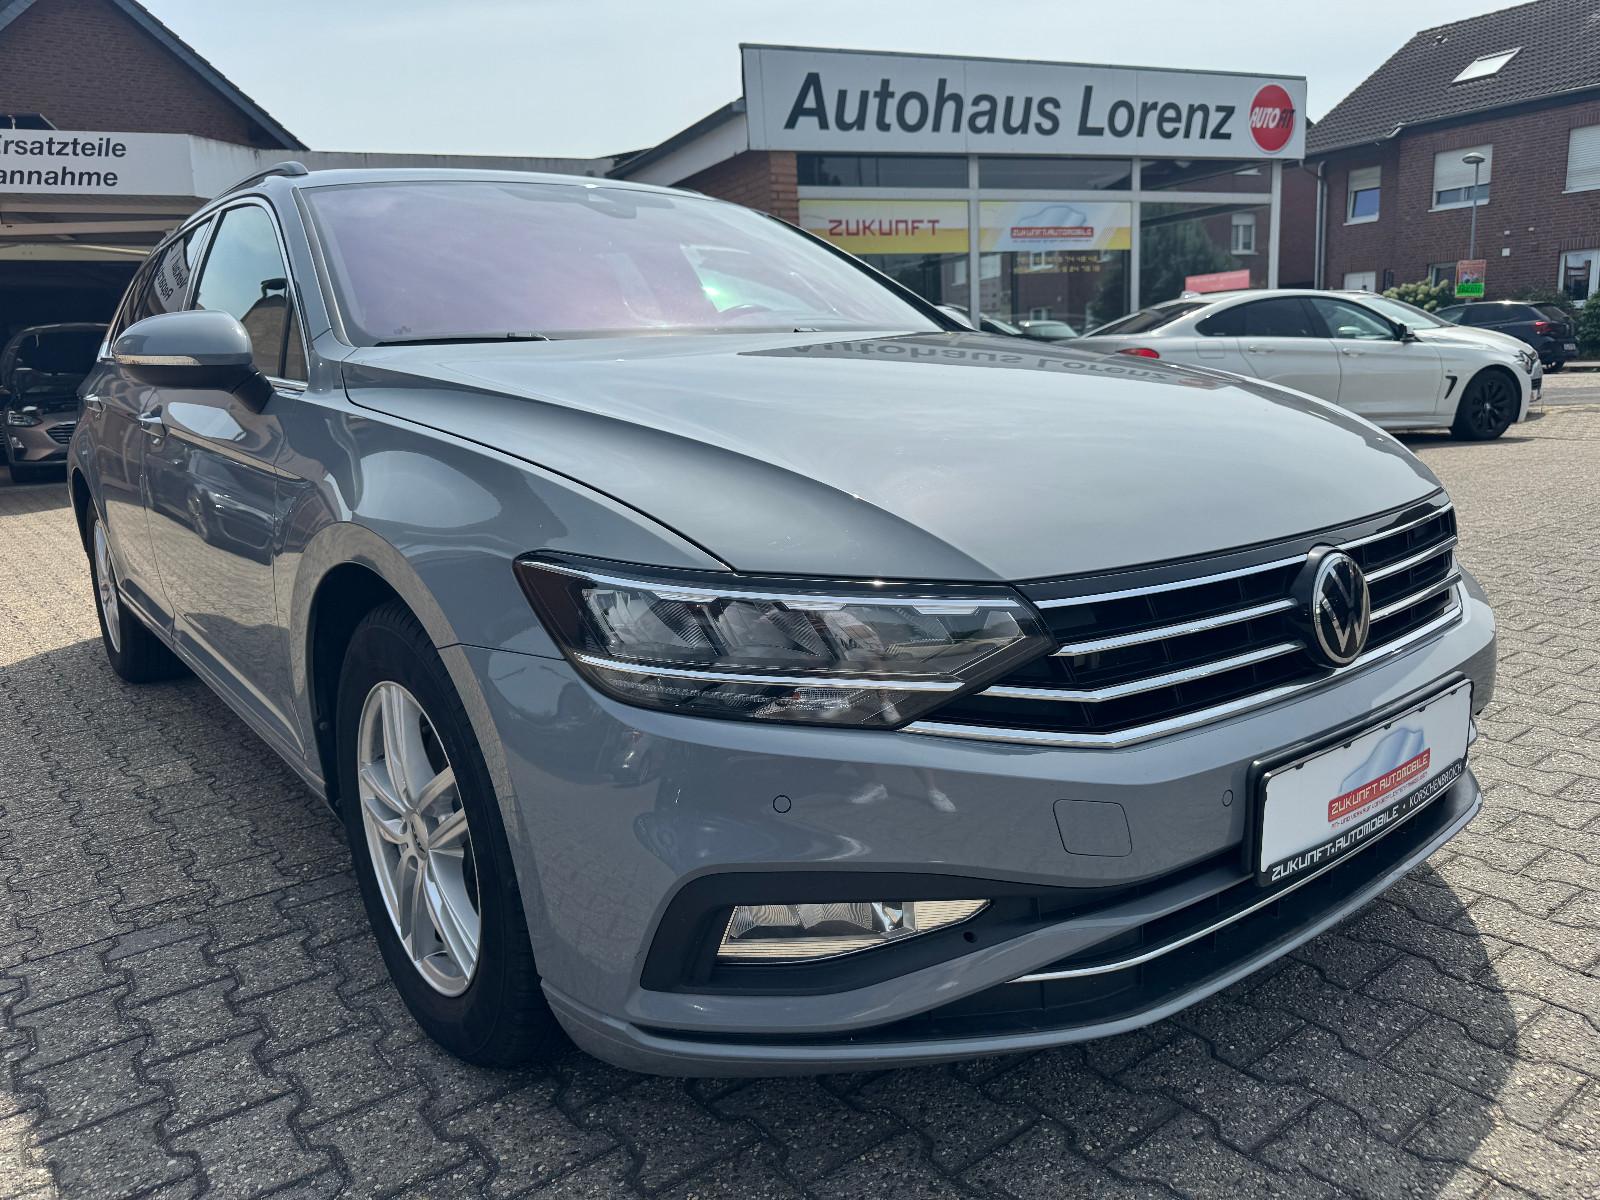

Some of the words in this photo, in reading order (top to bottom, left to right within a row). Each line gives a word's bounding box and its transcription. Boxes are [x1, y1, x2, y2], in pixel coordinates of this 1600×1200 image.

[783, 71, 1061, 136] Autohaus
[1077, 85, 1235, 140] Lorenz
[0, 166, 118, 187] annahme
[828, 218, 940, 237] ZUKUNFT
[1331, 783, 1377, 816] ZUKUNFT
[1379, 753, 1429, 792] AUTOMOBILE
